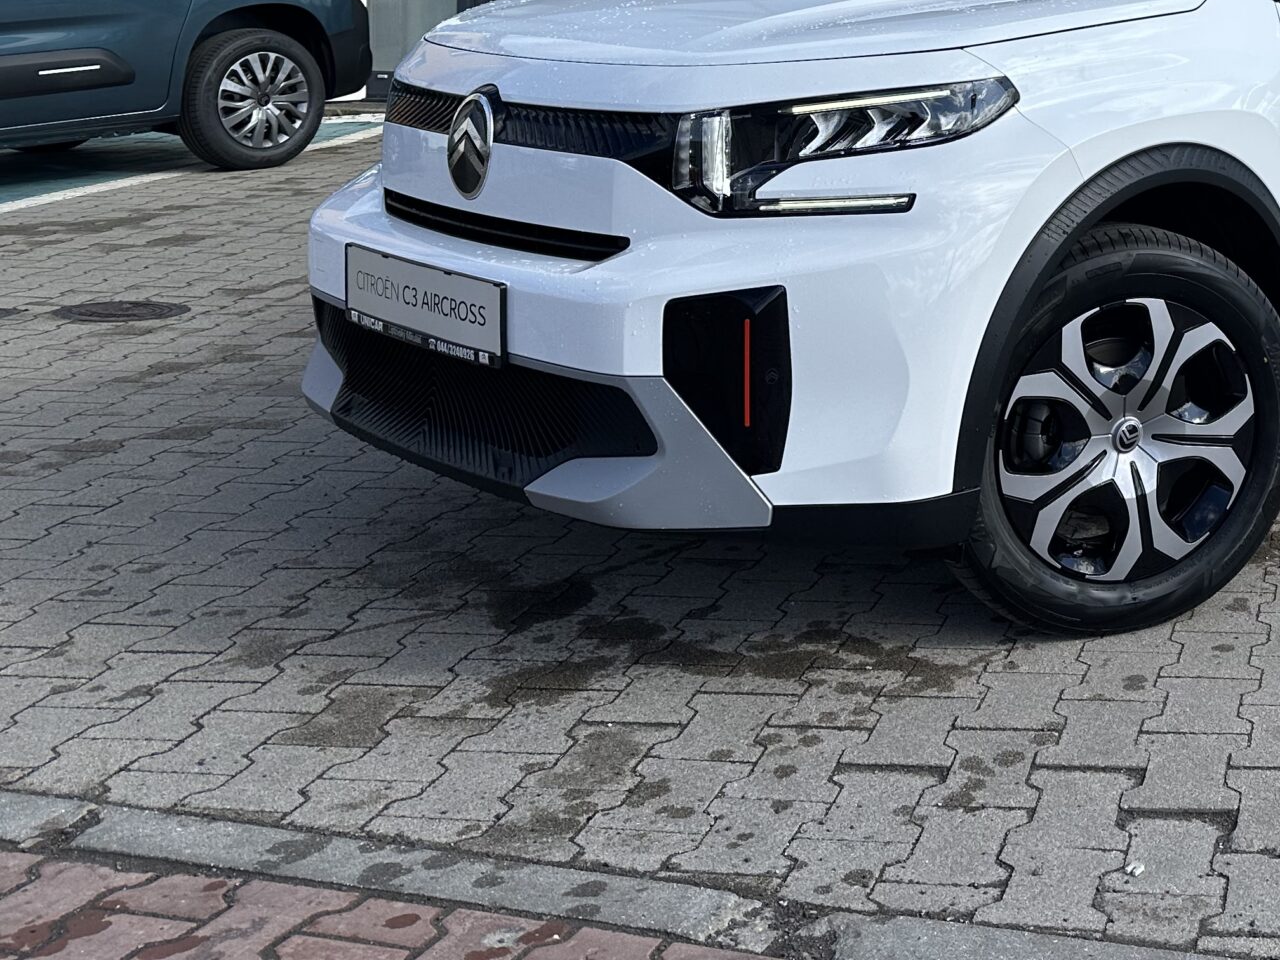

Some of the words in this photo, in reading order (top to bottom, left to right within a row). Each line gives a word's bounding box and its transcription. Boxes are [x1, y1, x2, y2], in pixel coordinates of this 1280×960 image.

[356, 270, 400, 303] CITROËN
[402, 285, 418, 307] C3
[421, 290, 487, 327] AIRCROSS
